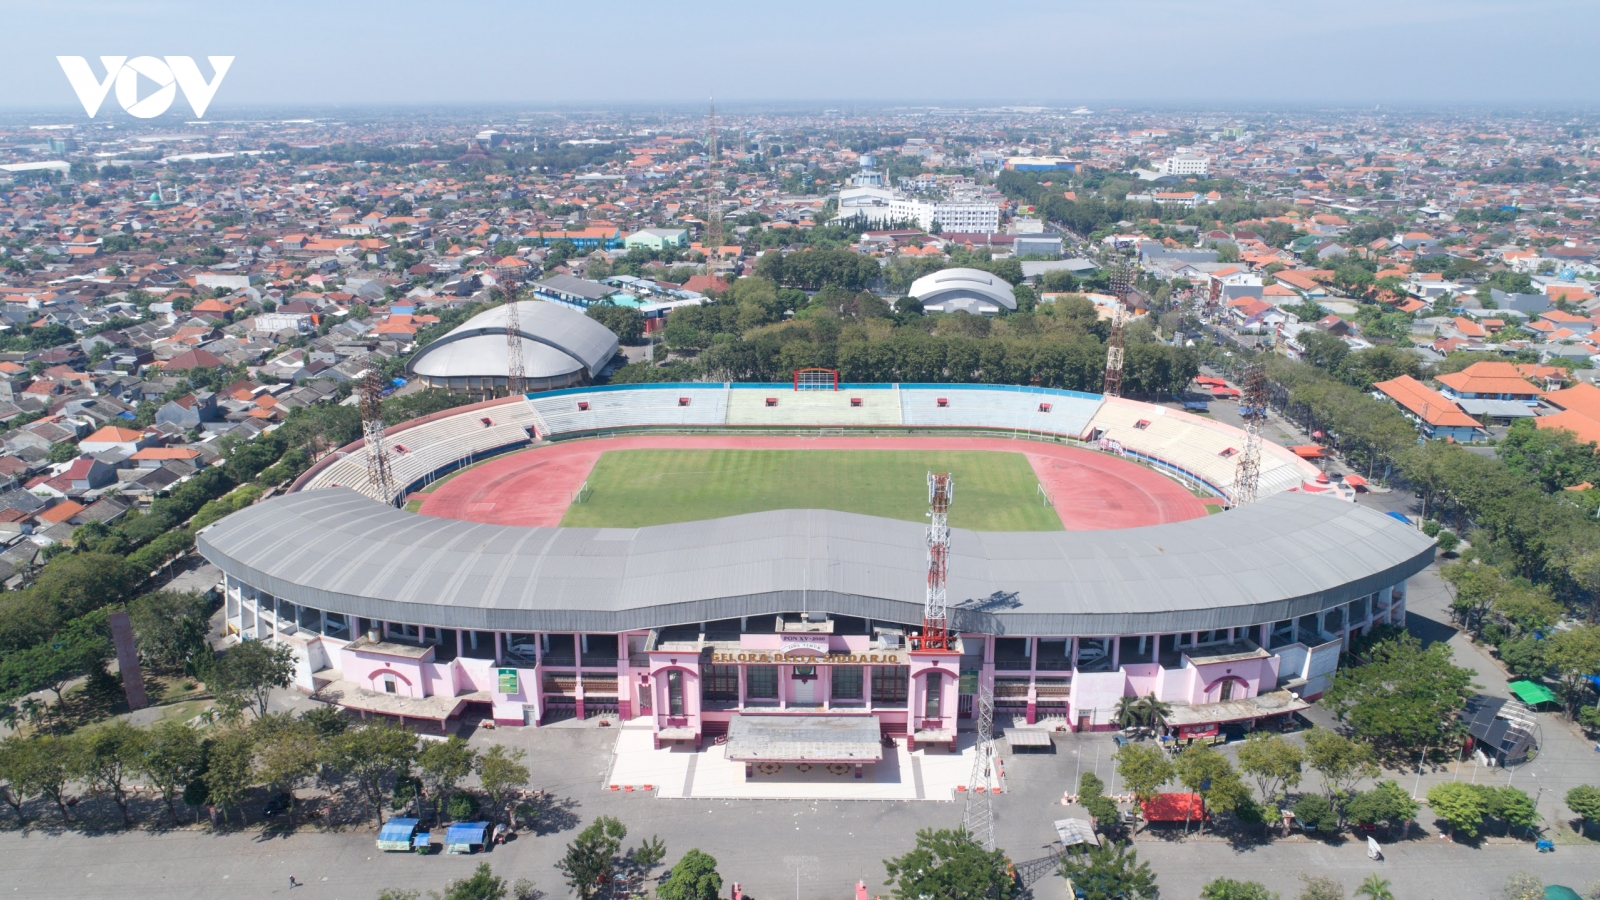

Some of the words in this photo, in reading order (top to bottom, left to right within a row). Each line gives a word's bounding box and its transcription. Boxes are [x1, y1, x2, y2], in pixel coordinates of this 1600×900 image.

[710, 652, 768, 663] GELORA
[775, 653, 819, 663] DELTA
[822, 653, 898, 664] SIDOARJO
